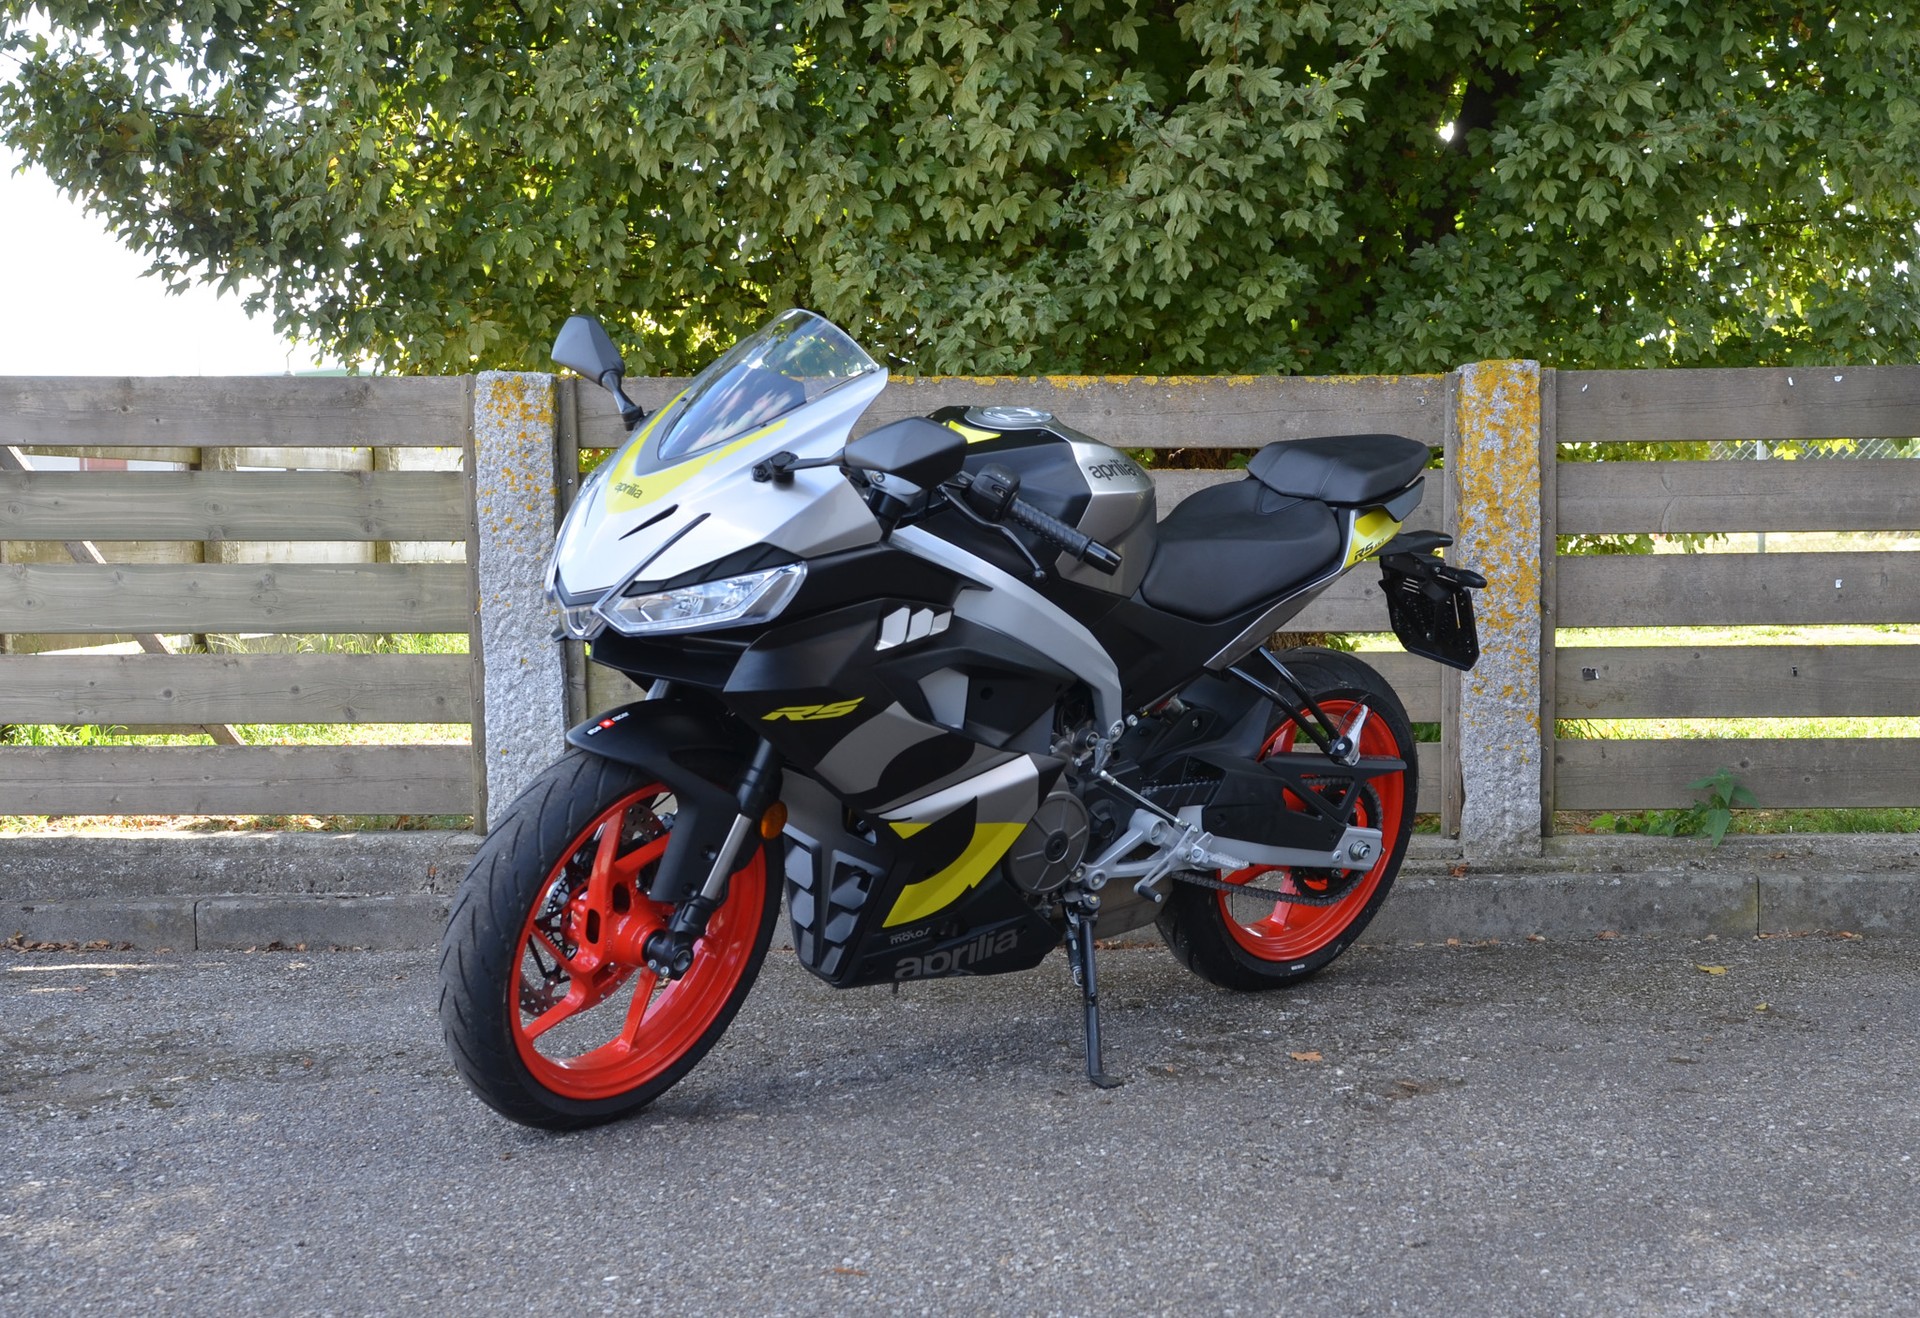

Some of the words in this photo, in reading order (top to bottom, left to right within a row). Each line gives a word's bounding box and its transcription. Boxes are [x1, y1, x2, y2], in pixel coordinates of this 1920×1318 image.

[1088, 459, 1137, 481] aprilia
[615, 482, 643, 499] aprilia
[1354, 541, 1374, 561] RS
[761, 696, 865, 721] RS
[894, 928, 1018, 979] aprilia
